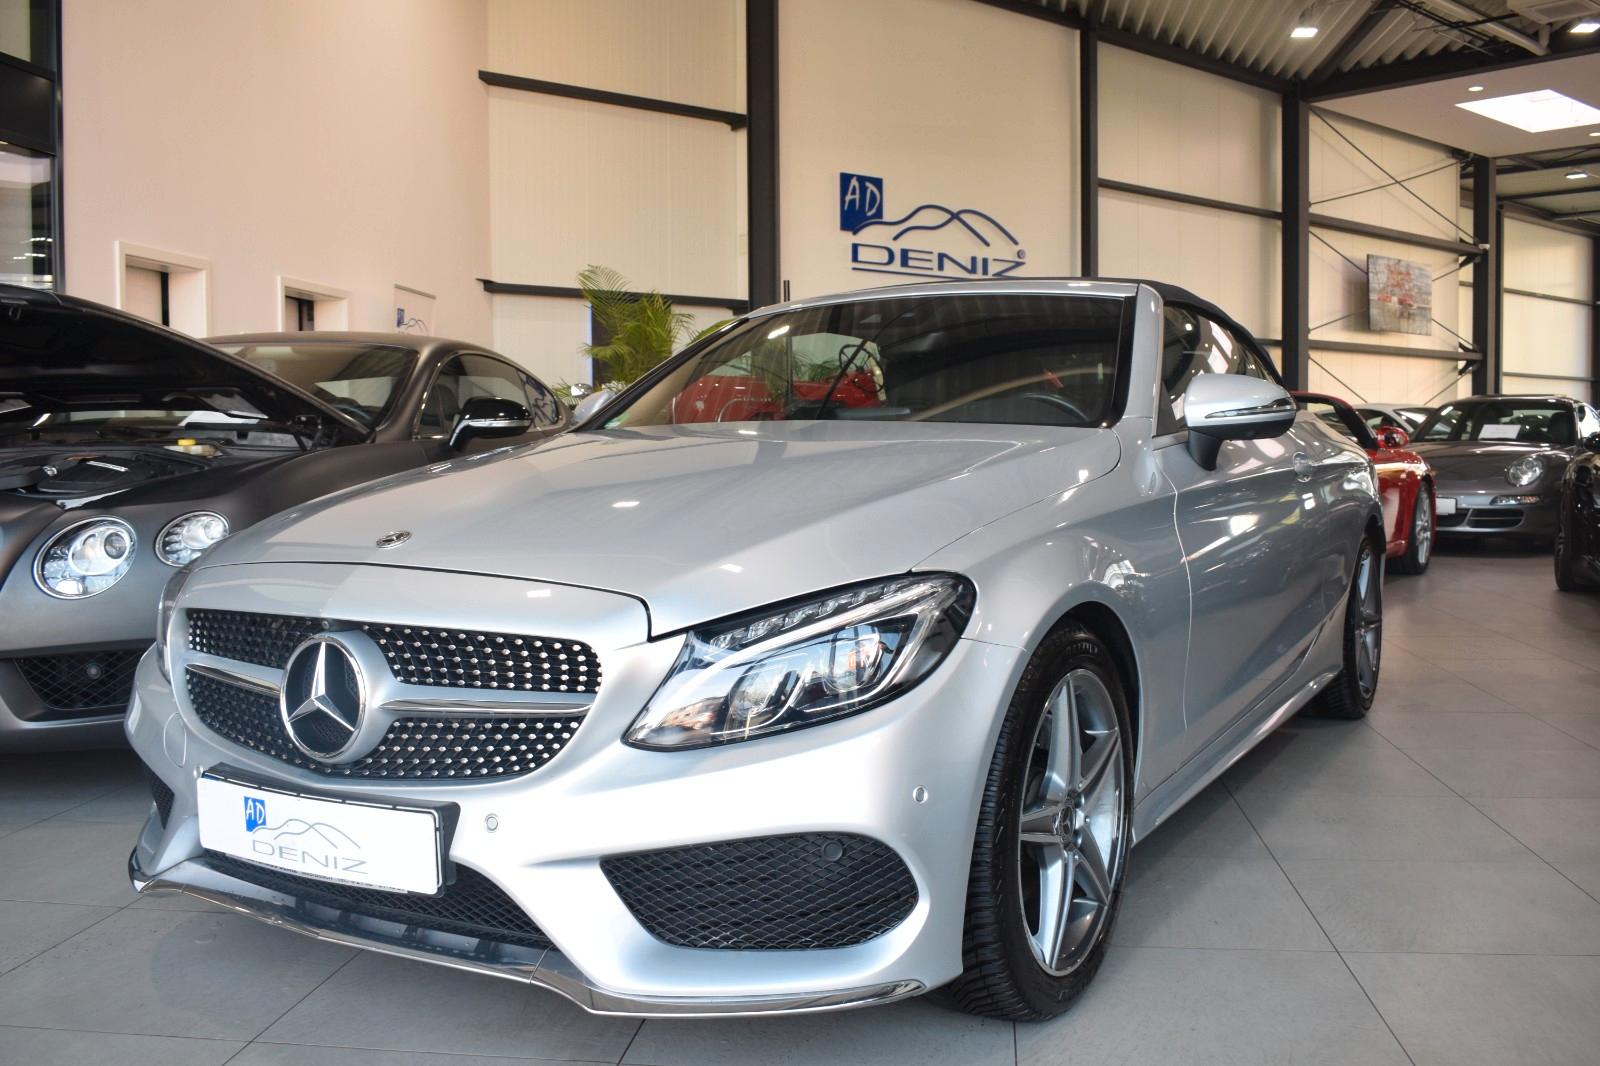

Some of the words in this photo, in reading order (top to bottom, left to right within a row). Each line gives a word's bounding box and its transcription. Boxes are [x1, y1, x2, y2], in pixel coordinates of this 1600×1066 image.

[844, 175, 881, 217] AD
[851, 242, 1026, 278] DENIZ
[245, 798, 265, 824] AD
[252, 839, 369, 875] DENIZ
